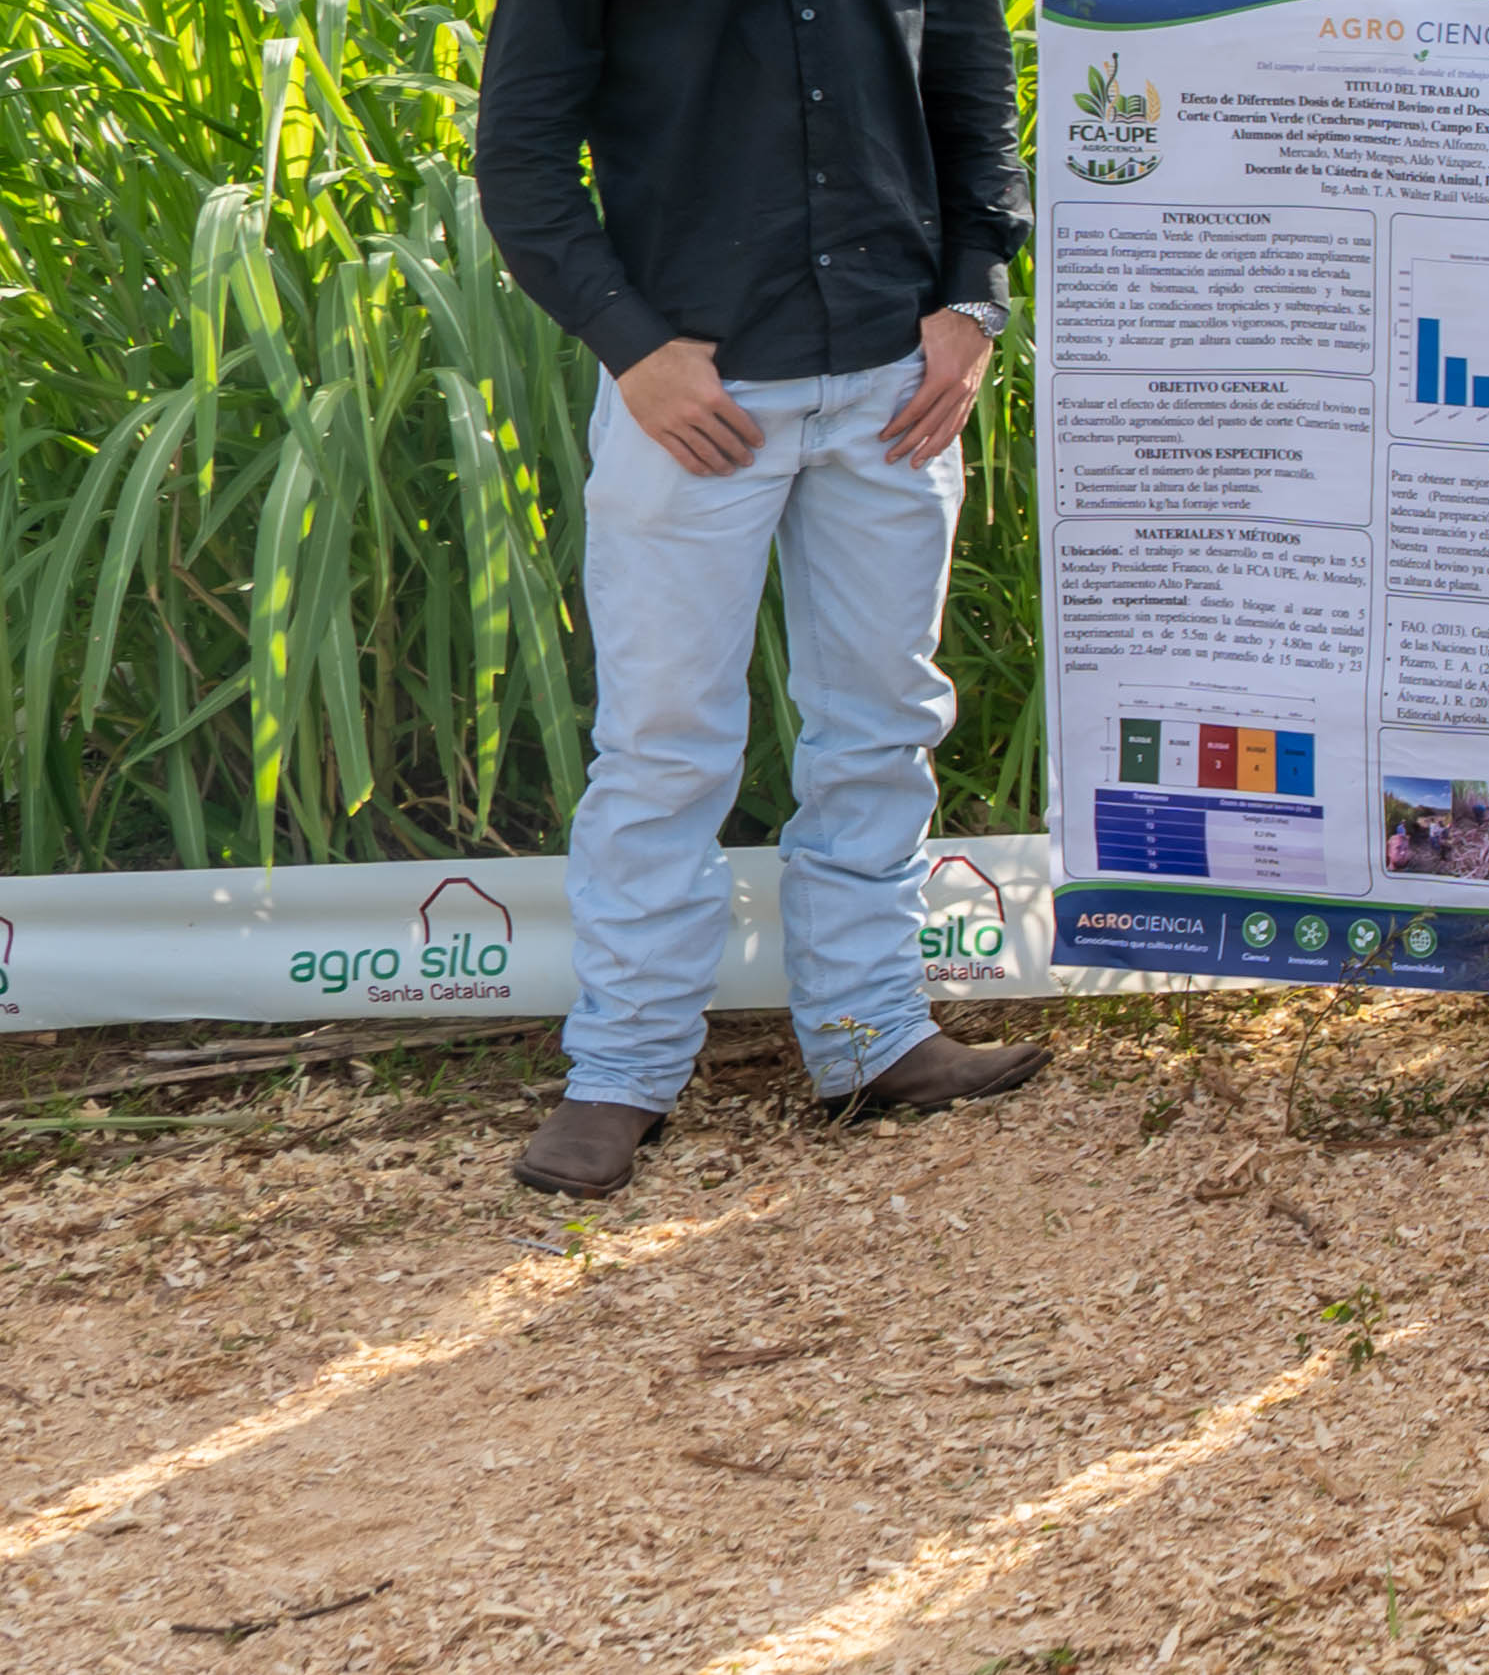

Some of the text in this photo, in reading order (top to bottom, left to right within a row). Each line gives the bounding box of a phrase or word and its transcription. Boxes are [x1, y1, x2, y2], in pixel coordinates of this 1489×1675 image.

[1319, 17, 1404, 41] AGRO
[1346, 80, 1479, 97] TITULO DEL TRABAJO
[1180, 93, 1217, 104] Efecto
[1220, 93, 1233, 104] de
[1236, 94, 1295, 106] Diferentes
[1298, 95, 1328, 107] Dosis
[1331, 97, 1344, 107] de
[1397, 100, 1434, 113] Bovino
[1436, 105, 1450, 114] en
[1453, 103, 1463, 115] el
[1177, 110, 1210, 121] Corte
[1271, 112, 1304, 124] Verde
[1430, 120, 1472, 135] Campo
[1069, 125, 1157, 143] FCA-UPE
[1245, 163, 1292, 175] Docente
[1294, 164, 1308, 174] de
[1311, 164, 1322, 174] la
[1325, 165, 1368, 177] Cátedra
[1370, 168, 1383, 179] de
[1386, 169, 1435, 183] Nutrición
[1438, 173, 1482, 186] Animal,
[1148, 381, 1287, 392] OBJETIVO GENERAL
[1134, 447, 1212, 459] OBJETIVOS
[1134, 526, 1224, 541] MATERIALES
[1227, 528, 1235, 539] Y
[1076, 913, 1205, 934] AGROCIENCIA
[919, 915, 1003, 959] silo
[289, 933, 508, 994] agro silo
[926, 962, 1005, 982] Catalina
[367, 981, 511, 1003] Santa Catalina
